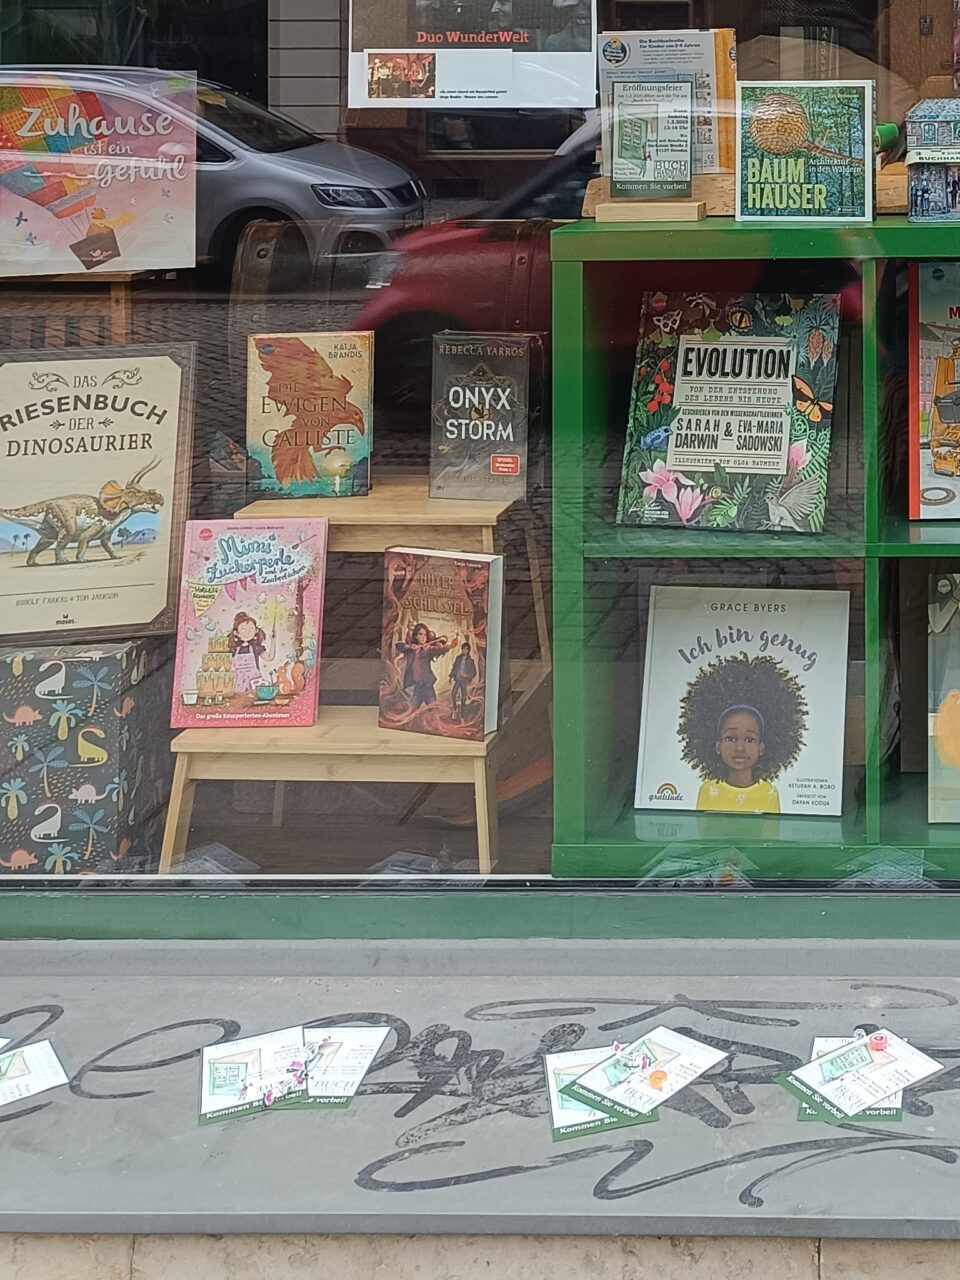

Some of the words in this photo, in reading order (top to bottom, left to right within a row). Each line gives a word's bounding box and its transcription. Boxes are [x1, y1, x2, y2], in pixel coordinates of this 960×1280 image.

[416, 32, 443, 43] Duo
[446, 31, 529, 43] WunderWelt
[622, 84, 684, 93] Eröffnungsfeier
[16, 103, 174, 138] Zuhause
[84, 141, 104, 155] ist
[109, 141, 133, 155] ein
[747, 158, 805, 183] BAUM
[662, 182, 687, 190] vorbei!
[747, 184, 827, 209] HÄUSER
[328, 350, 362, 359] BRANDIS
[334, 343, 358, 351] KATJA
[439, 345, 484, 356] REBECCA
[487, 346, 524, 357] YARROS
[681, 347, 791, 380] EVOLUTION
[73, 375, 97, 388] DAS
[278, 383, 300, 393] DIE
[449, 386, 512, 410] ONYX
[708, 386, 723, 394] DER
[728, 387, 778, 395] ENTSTEHUNG
[261, 396, 347, 414] EWIGEN
[756, 396, 782, 404] HEUTE
[0, 394, 168, 432] RIESENBUCH
[69, 417, 95, 431] DER
[302, 417, 331, 427] VON
[676, 418, 720, 432] SARAH
[724, 422, 733, 437] &
[738, 420, 783, 435] EVA-MARIA
[262, 429, 355, 448] CALLISTE
[445, 419, 514, 442] STORM
[6, 433, 153, 457] DINOSAURIER
[675, 433, 719, 450] DARWIN
[736, 435, 783, 452] SADOWSKI
[218, 534, 277, 565] Mimi
[206, 548, 295, 583] Zuckerperle
[711, 603, 748, 613] GRACE
[754, 604, 787, 613] BYERS
[678, 636, 713, 665] Ich
[715, 625, 754, 649] bin
[759, 630, 818, 671] genug
[648, 792, 685, 802] gratitude
